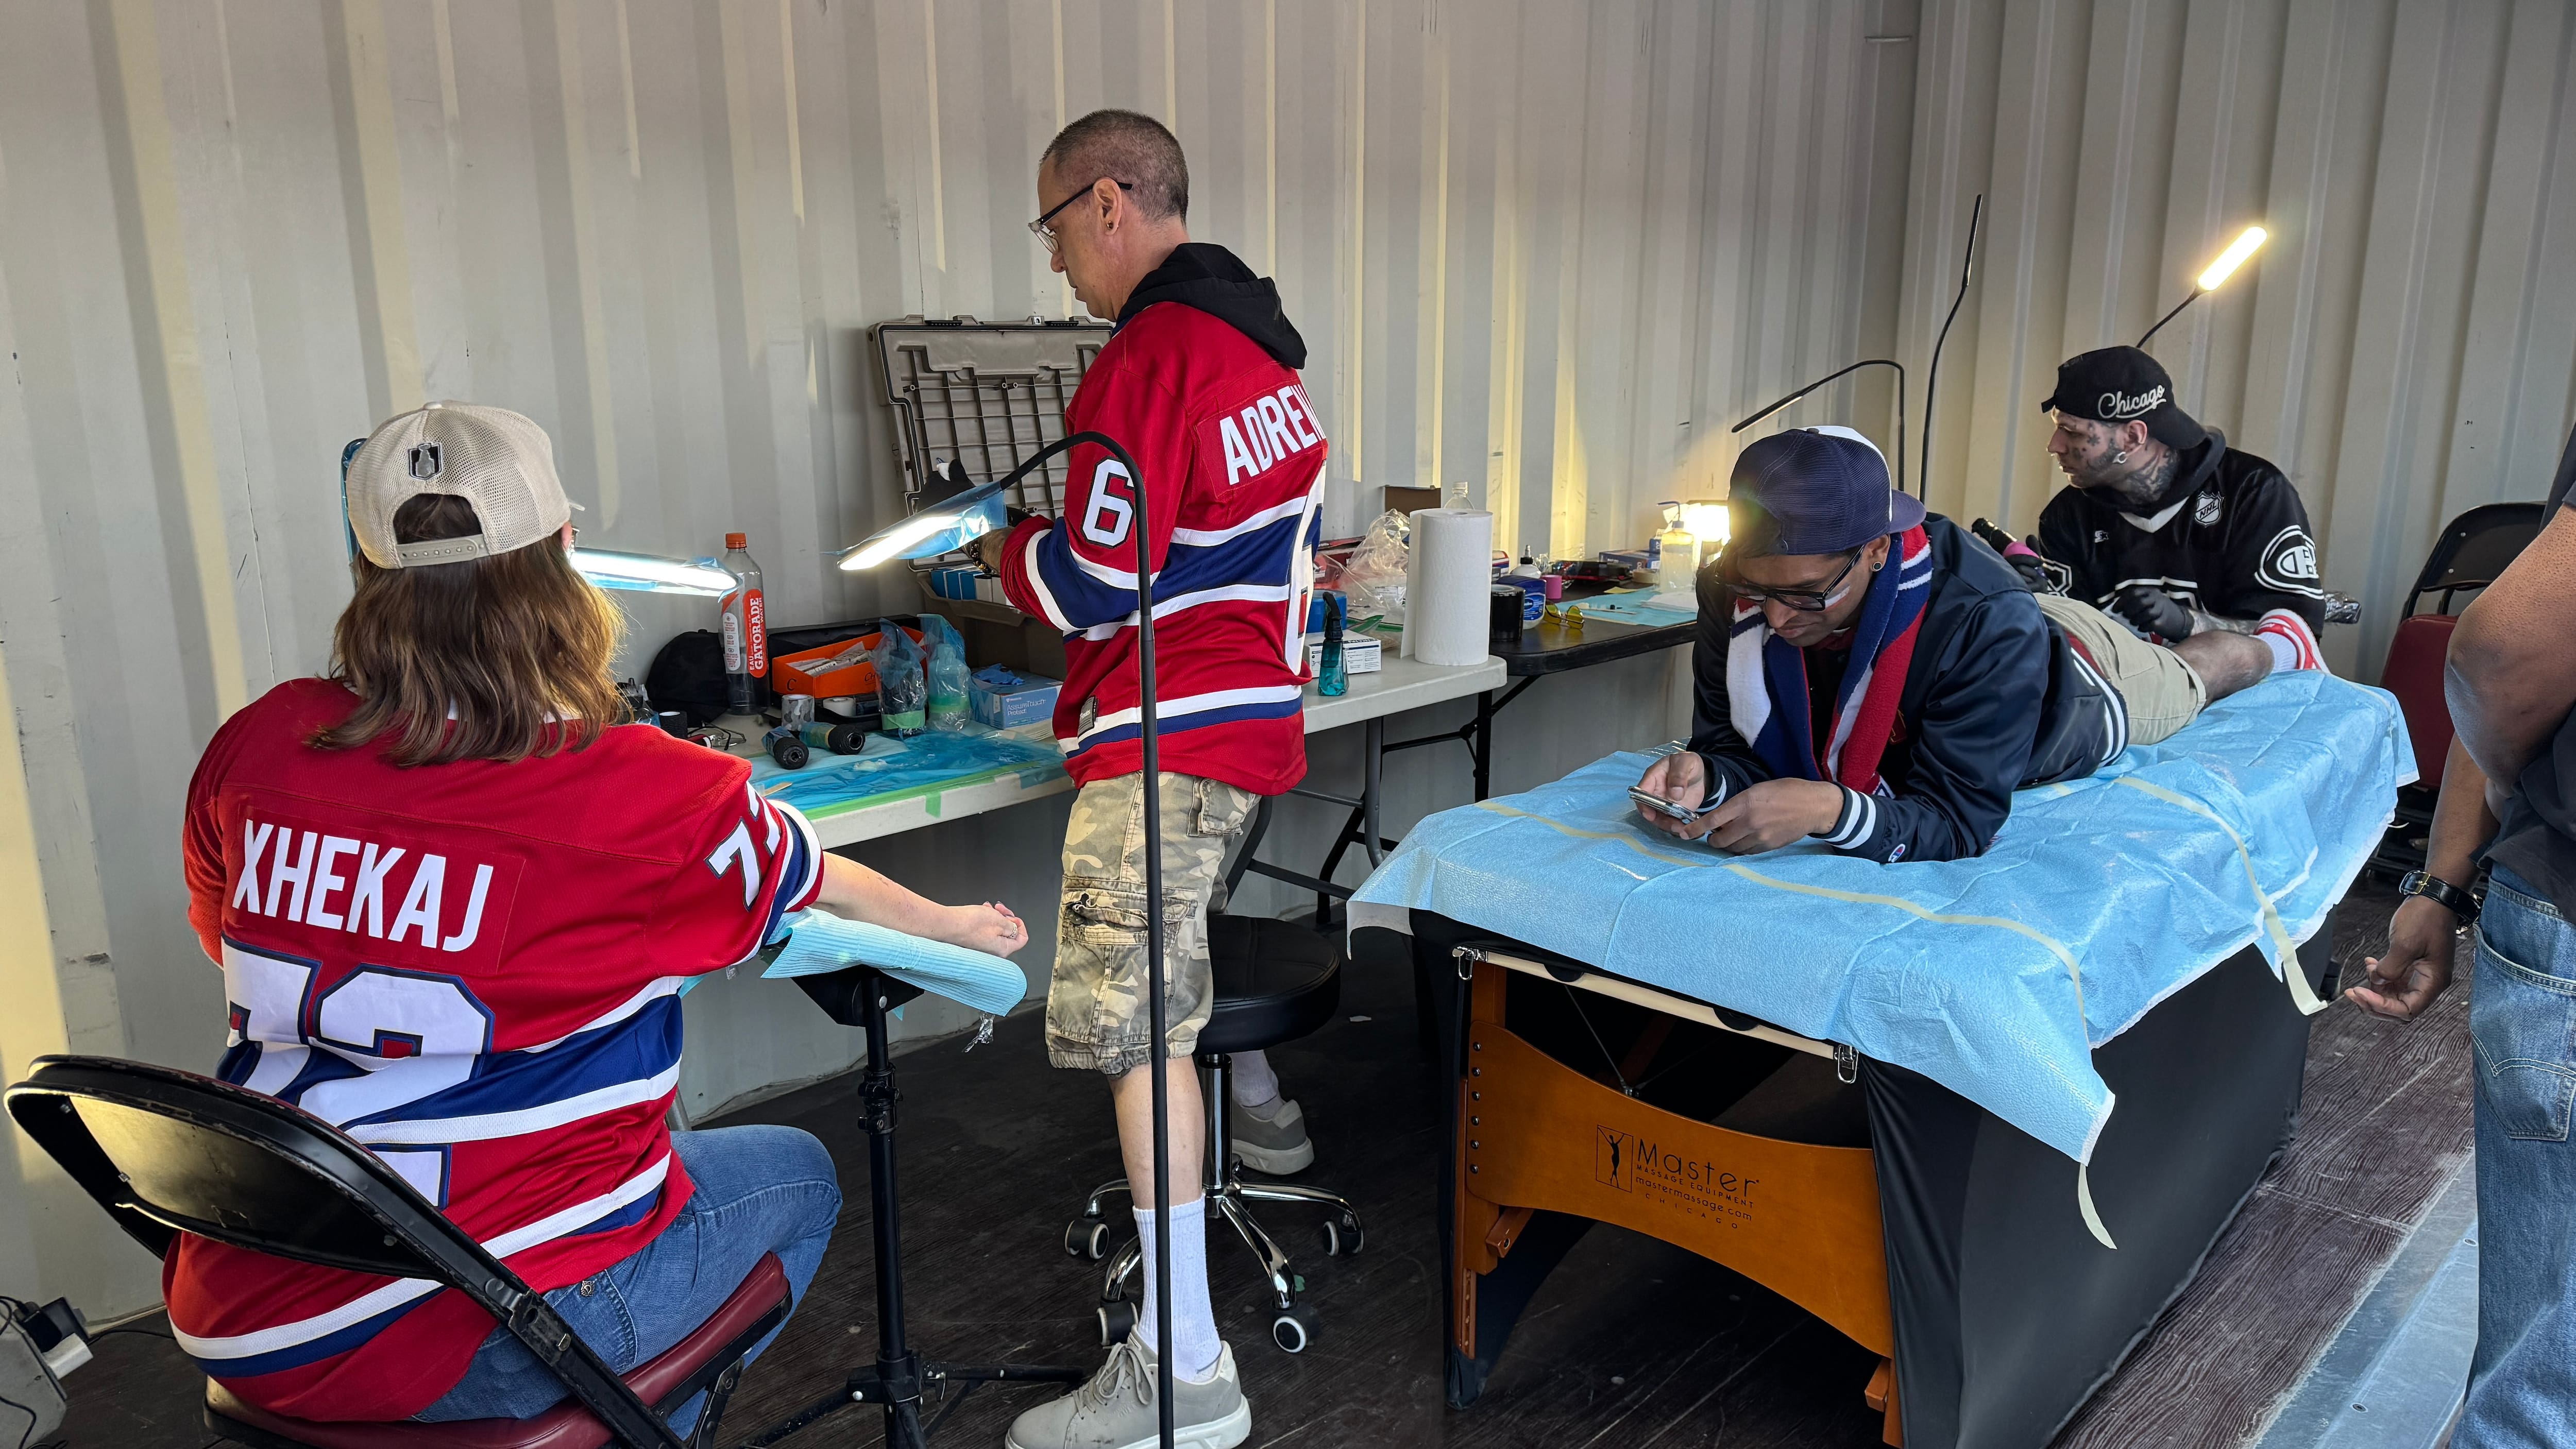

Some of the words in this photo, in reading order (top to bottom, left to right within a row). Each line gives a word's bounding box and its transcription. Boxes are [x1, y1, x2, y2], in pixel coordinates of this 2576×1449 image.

[2098, 384, 2166, 418] Chicago
[1081, 458, 1134, 547] 6
[2199, 500, 2217, 518] NHL
[750, 598, 764, 670] GATORADE
[232, 819, 493, 952] XHEKAJ
[1636, 1164, 1684, 1185] MASSAGE
[1690, 1182, 1754, 1208] EQUIPMENT
[1638, 1138, 1756, 1197] Master
[1636, 1177, 1752, 1221] mastermassagecom
[1646, 1193, 1738, 1229] CHICAGO
